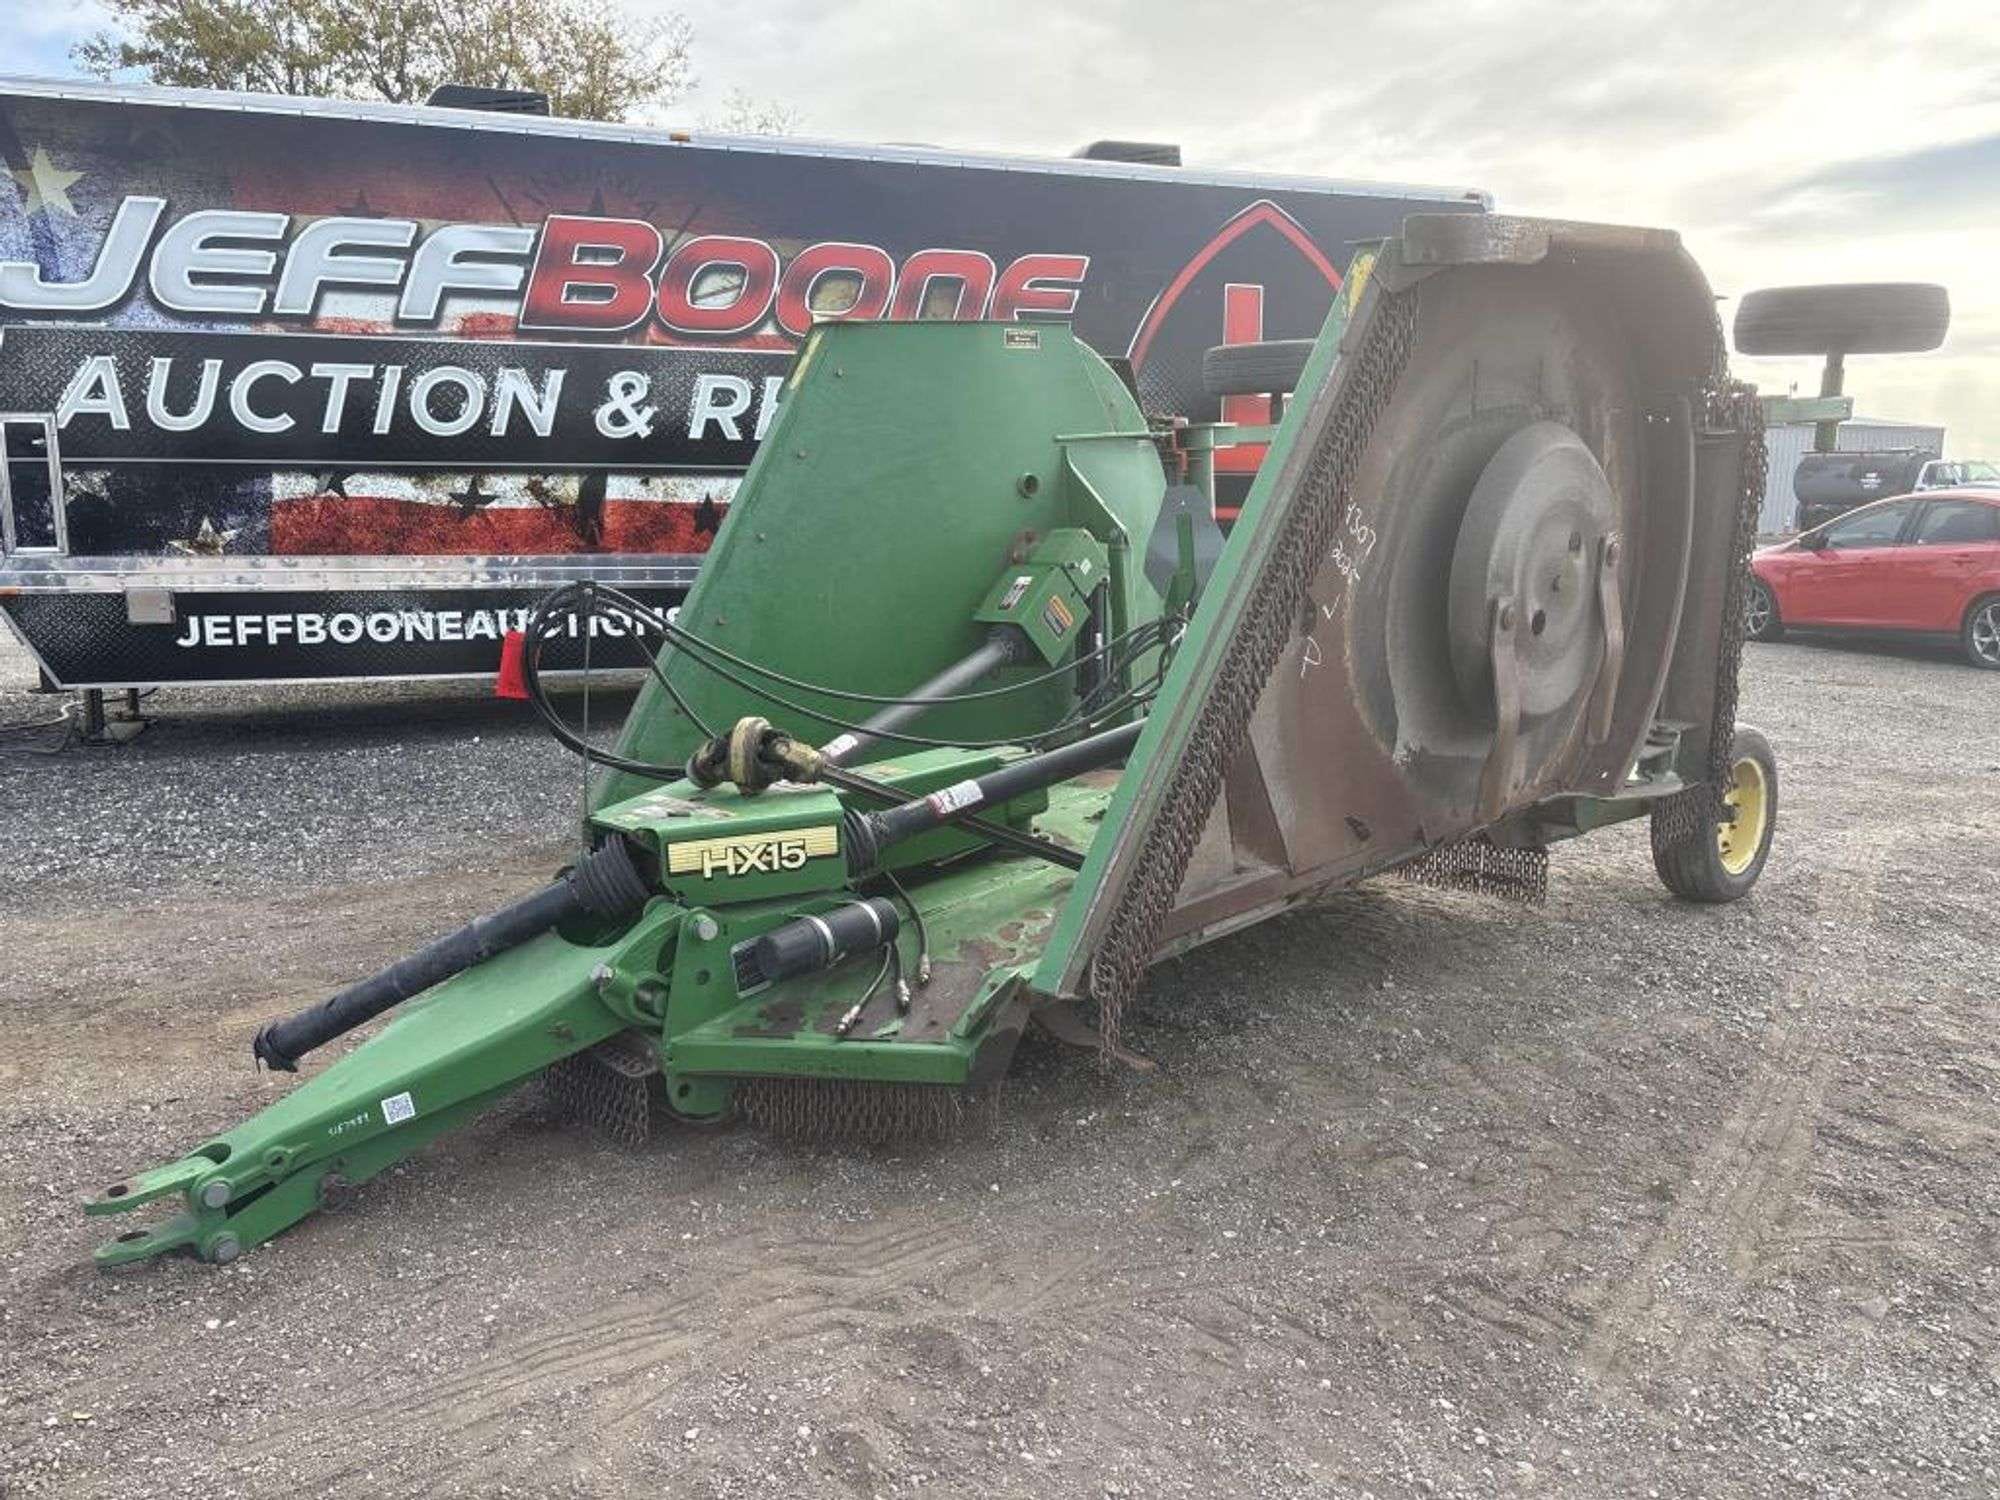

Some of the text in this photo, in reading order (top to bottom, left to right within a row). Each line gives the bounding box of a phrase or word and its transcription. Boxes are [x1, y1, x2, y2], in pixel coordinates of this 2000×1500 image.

[57, 355, 567, 437] AUCTION
[594, 370, 654, 438] &
[701, 839, 807, 879] HX15
